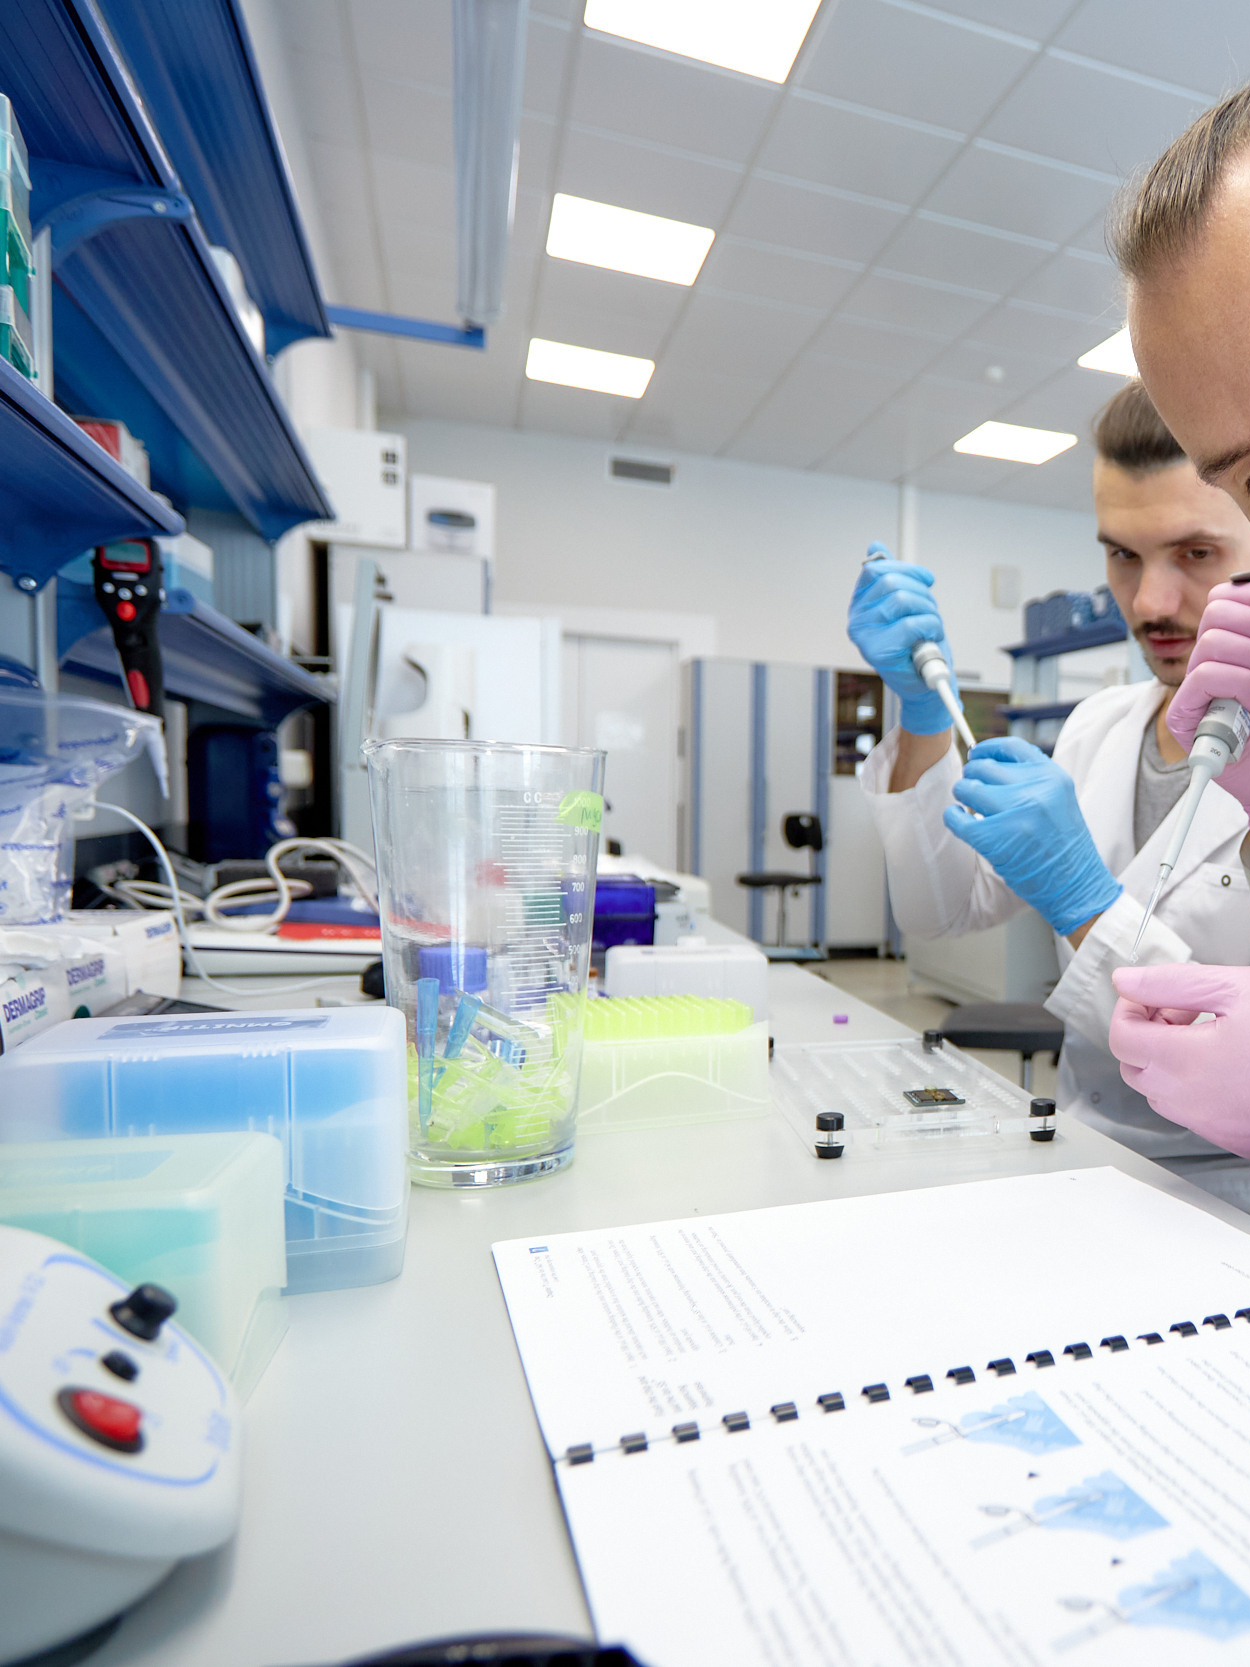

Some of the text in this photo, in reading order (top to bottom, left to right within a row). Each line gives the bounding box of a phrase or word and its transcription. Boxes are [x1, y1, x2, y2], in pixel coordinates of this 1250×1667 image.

[1210, 747, 1222, 756] 200
[571, 882, 585, 892] 700
[569, 912, 583, 924] 600
[568, 944, 580, 955] 500
[2, 987, 46, 1023] DERMAGRIP
